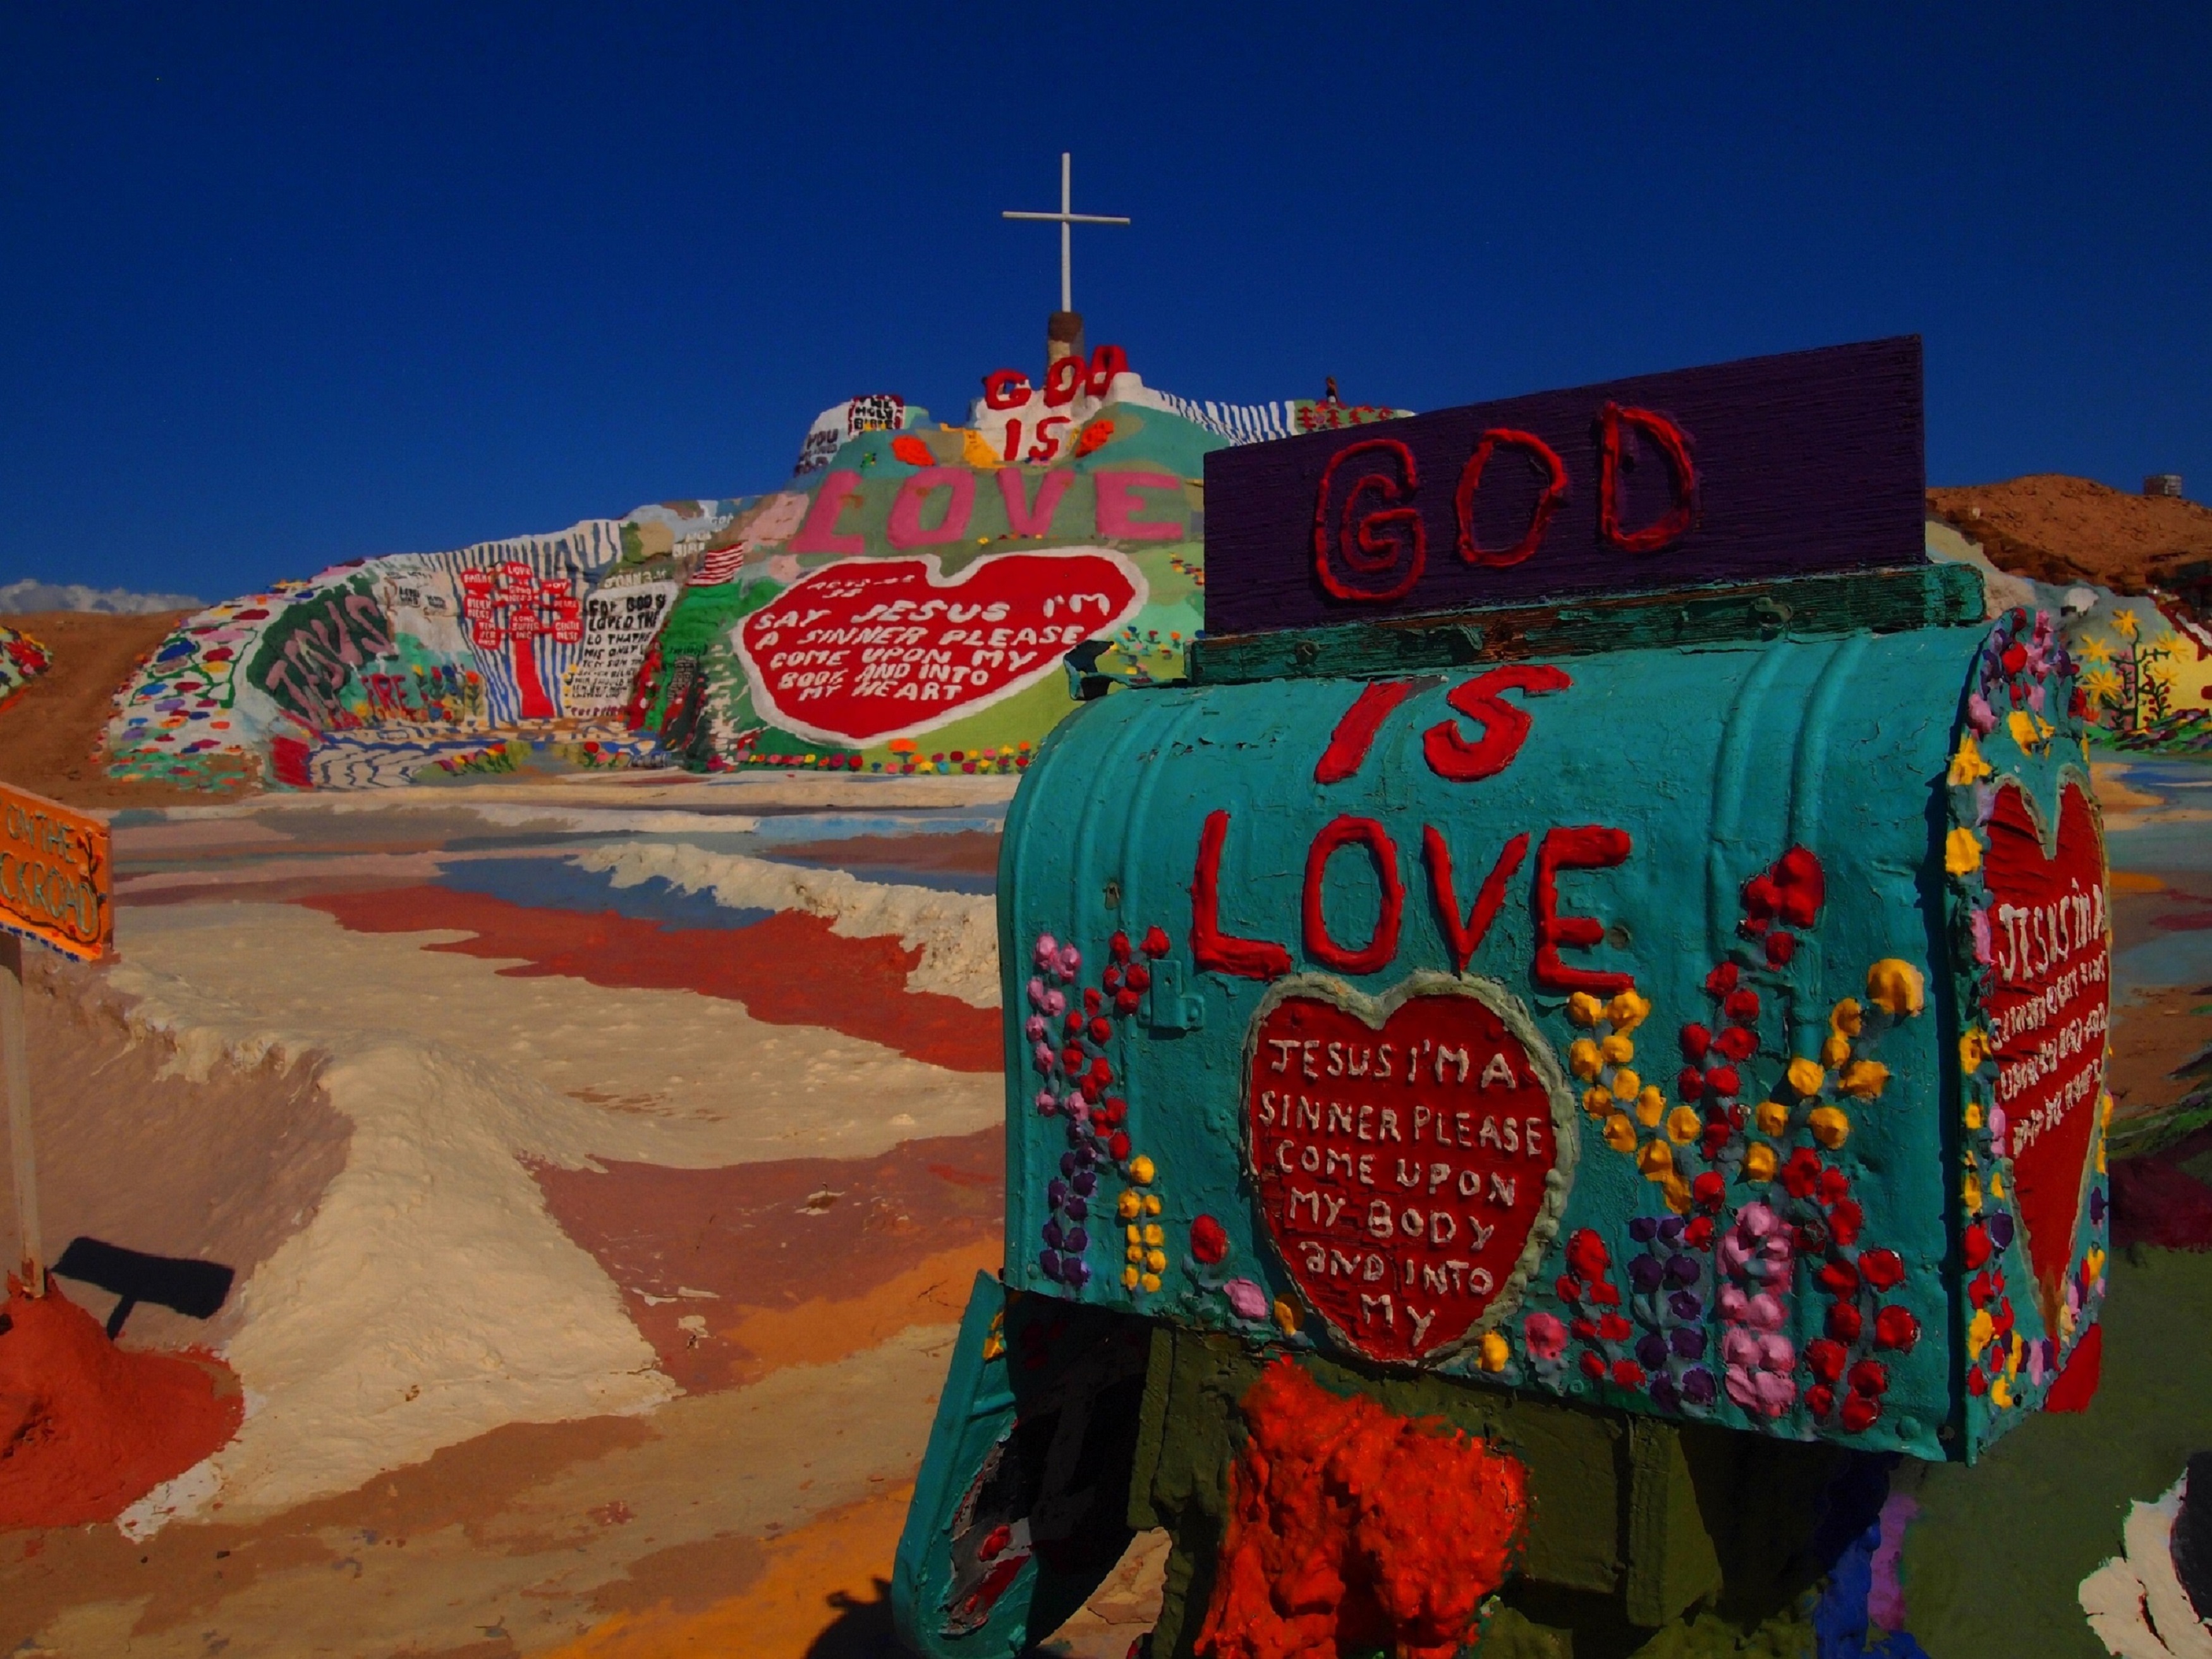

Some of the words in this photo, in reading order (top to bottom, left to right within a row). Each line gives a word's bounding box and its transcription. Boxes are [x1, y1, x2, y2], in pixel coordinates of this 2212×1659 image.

[983, 345, 1129, 410] GOD
[855, 407, 894, 419] HOLY
[1004, 416, 1072, 461] IS
[787, 468, 1184, 554] LOVE
[1313, 401, 1694, 602] GOD
[588, 615, 633, 631] LOVED
[753, 608, 832, 631] SAY
[850, 599, 1011, 624] JESUS
[1043, 593, 1112, 619] I'M
[798, 625, 929, 645] SINNER
[938, 625, 1086, 646] PLEASE
[770, 649, 851, 669] COME
[861, 646, 952, 665] UPON
[971, 650, 1038, 672] MY
[854, 662, 911, 681] AND
[918, 663, 989, 686] INTO
[798, 684, 841, 702] MY
[851, 681, 963, 702] HEART
[1314, 664, 1574, 785] IS
[35, 810, 78, 865] THE
[0, 851, 97, 934] CKROAD
[1191, 809, 1636, 992] LOVE
[1268, 1038, 1394, 1078] JESUS
[1407, 1038, 1470, 1084] I'M
[1480, 1053, 1517, 1090] A
[1258, 1090, 1402, 1143] SINNER
[1413, 1105, 1544, 1158] PLEASE
[1275, 1139, 1376, 1186] COME
[1397, 1158, 1517, 1208] UPON
[1289, 1186, 1346, 1228] MY
[1367, 1198, 1495, 1251] BODY
[1406, 1259, 1495, 1296] INTO
[1360, 1292, 1437, 1347] MY
